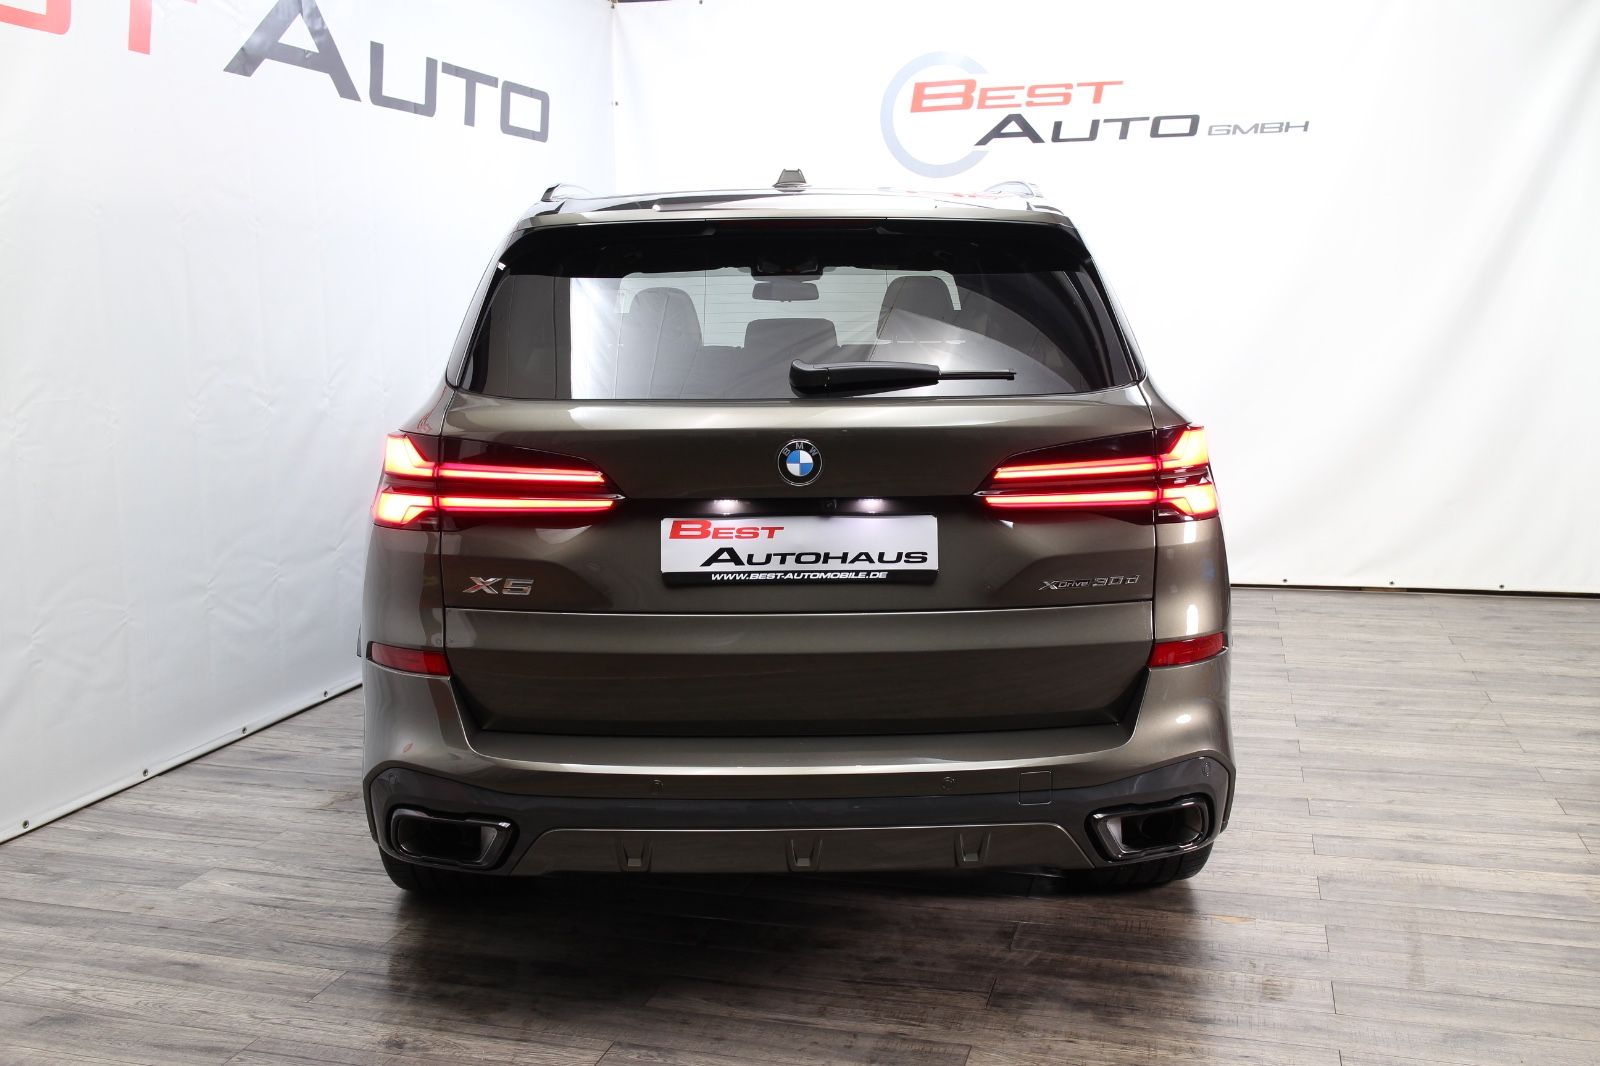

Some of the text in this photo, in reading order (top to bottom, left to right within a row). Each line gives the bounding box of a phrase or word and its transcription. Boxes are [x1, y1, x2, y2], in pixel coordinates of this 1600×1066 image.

[223, 0, 550, 143] AUTO
[910, 79, 1124, 113] BEST
[974, 113, 1310, 147] AUTO GMBH
[782, 442, 818, 457] BMW
[669, 520, 784, 540] BEST
[700, 547, 928, 567] AUTOHAUS
[462, 576, 535, 596] X5
[711, 571, 888, 581] WWW.BEST-AUTOMOBILE.DE
